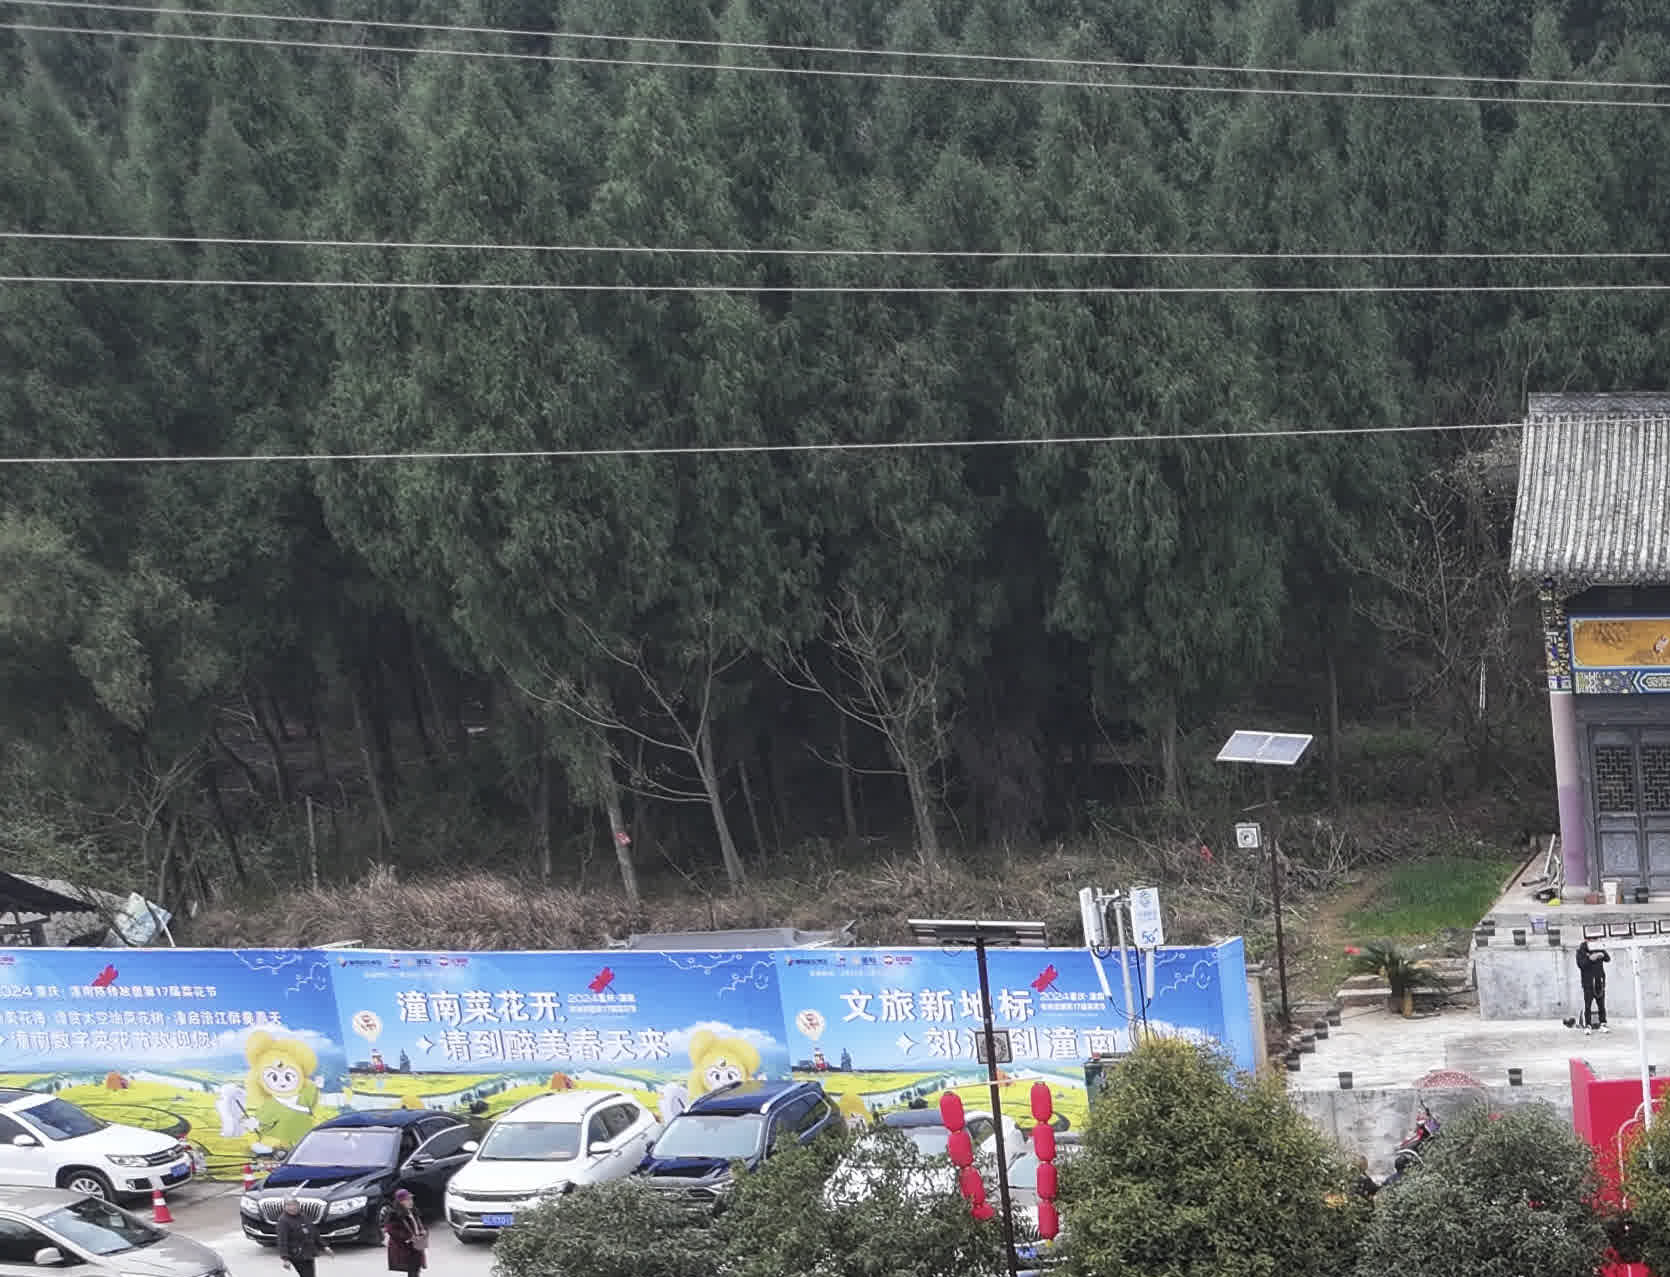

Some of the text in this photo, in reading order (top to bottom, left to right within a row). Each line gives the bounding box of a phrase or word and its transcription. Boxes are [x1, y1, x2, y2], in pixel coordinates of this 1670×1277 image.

[840, 988, 1036, 1023] 文旅新地标
[439, 1027, 671, 1061] 请到醉美春天来
[927, 1027, 1121, 1060] 郊到潼南
